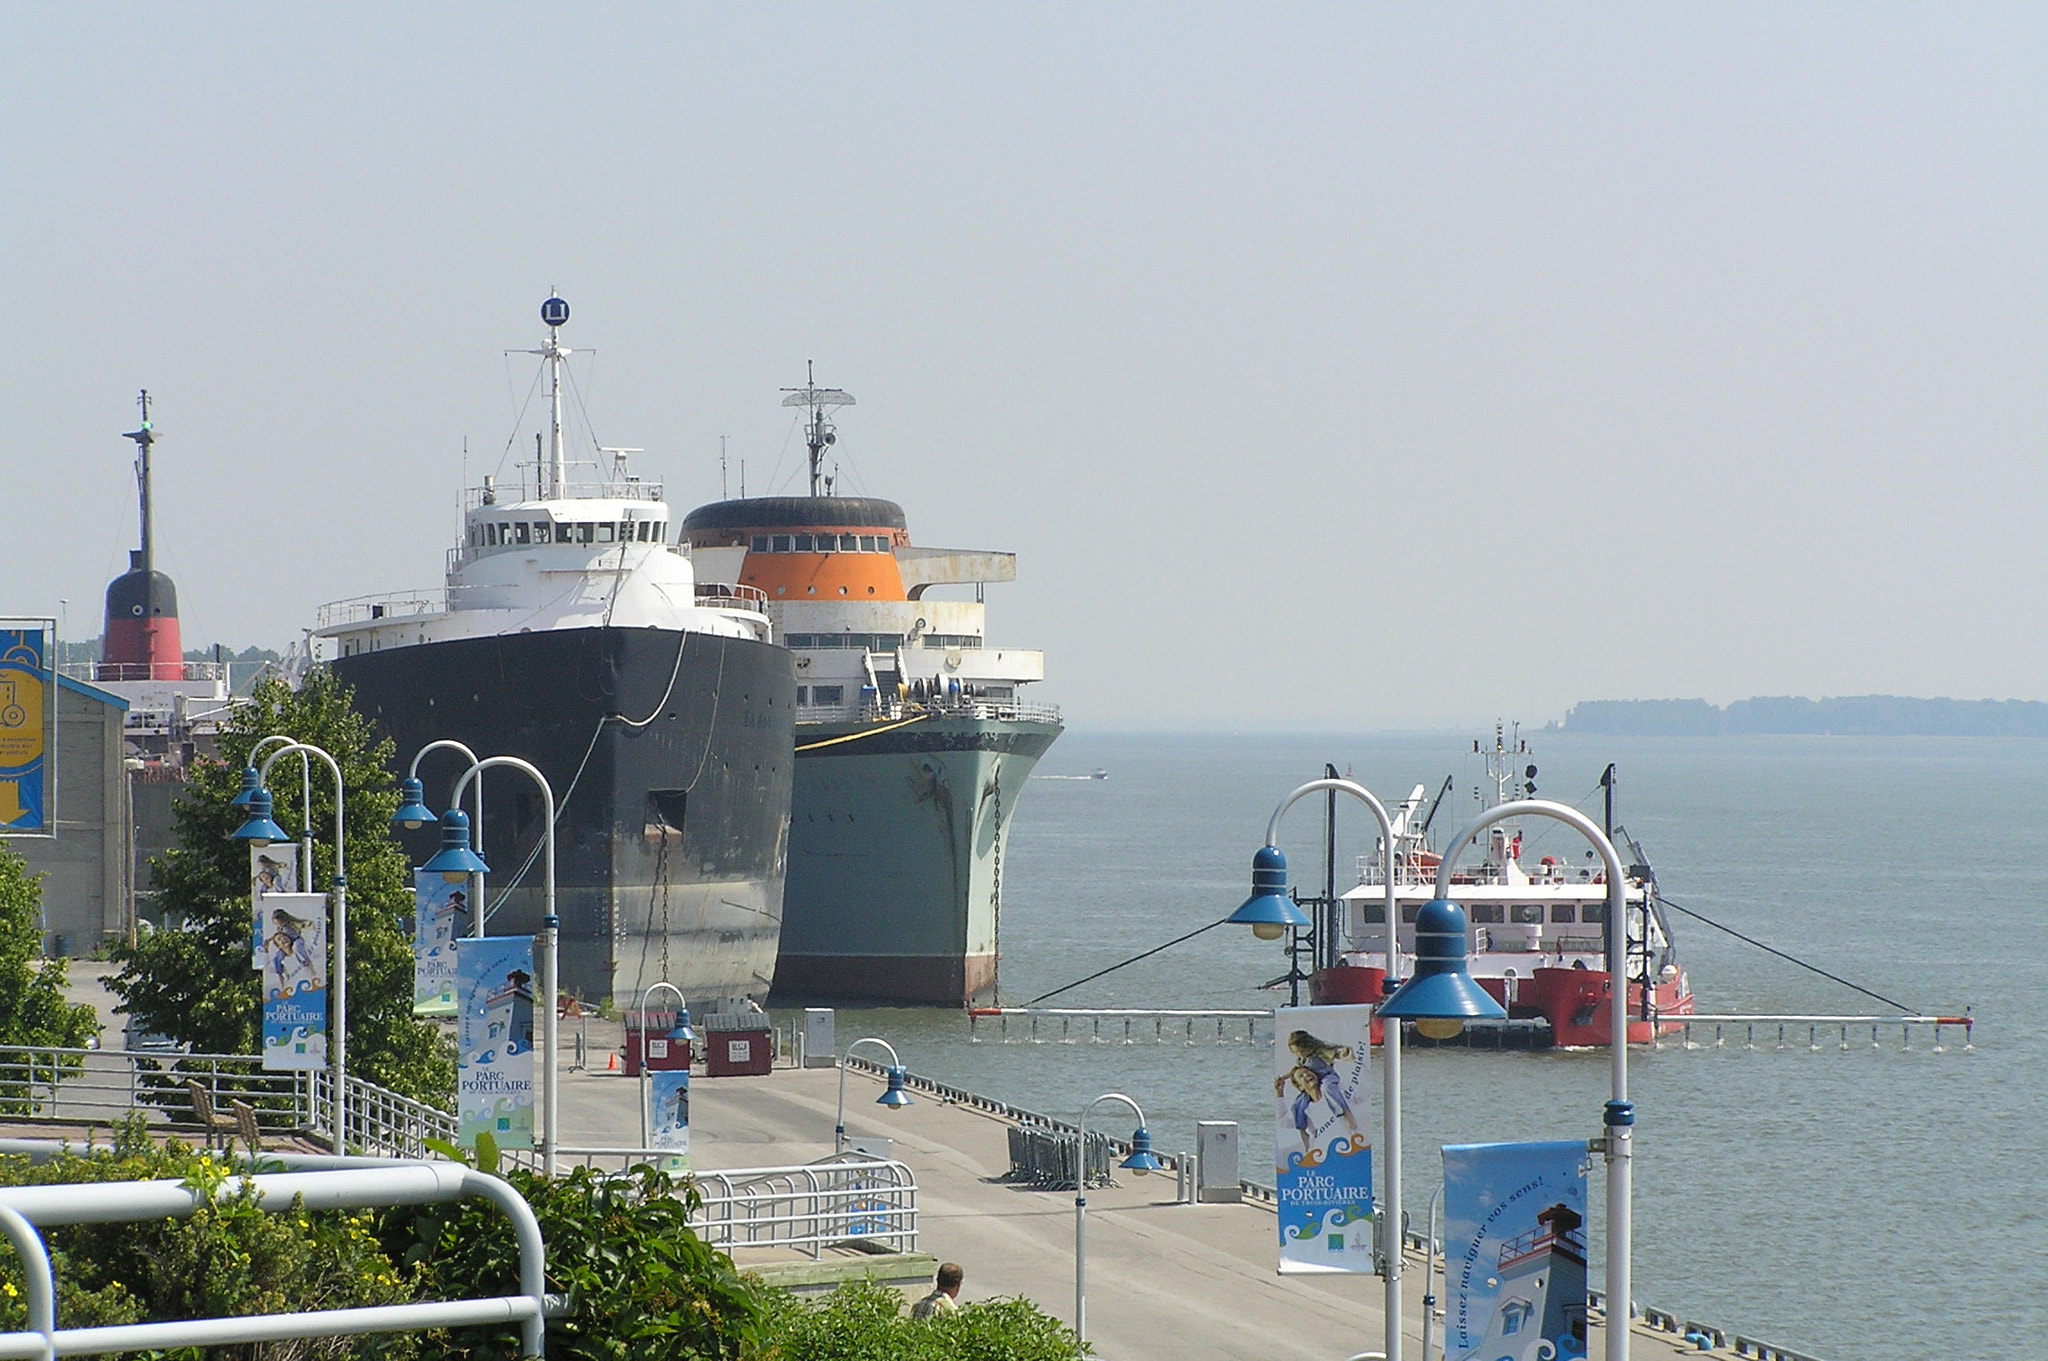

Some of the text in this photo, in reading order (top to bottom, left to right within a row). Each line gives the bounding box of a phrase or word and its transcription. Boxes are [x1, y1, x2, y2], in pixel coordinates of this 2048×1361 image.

[276, 1004, 301, 1013] PARC
[265, 1012, 323, 1021] PORTUAIRE
[476, 1071, 504, 1080] PARC
[462, 1081, 531, 1090] PORTUAIRE
[1314, 1041, 1367, 1139] Zone de plaisir!
[1298, 1176, 1334, 1188] PARC
[1282, 1187, 1368, 1201] PORTUAIRE
[1457, 1175, 1544, 1350] Laissez naviguer vos sens!
